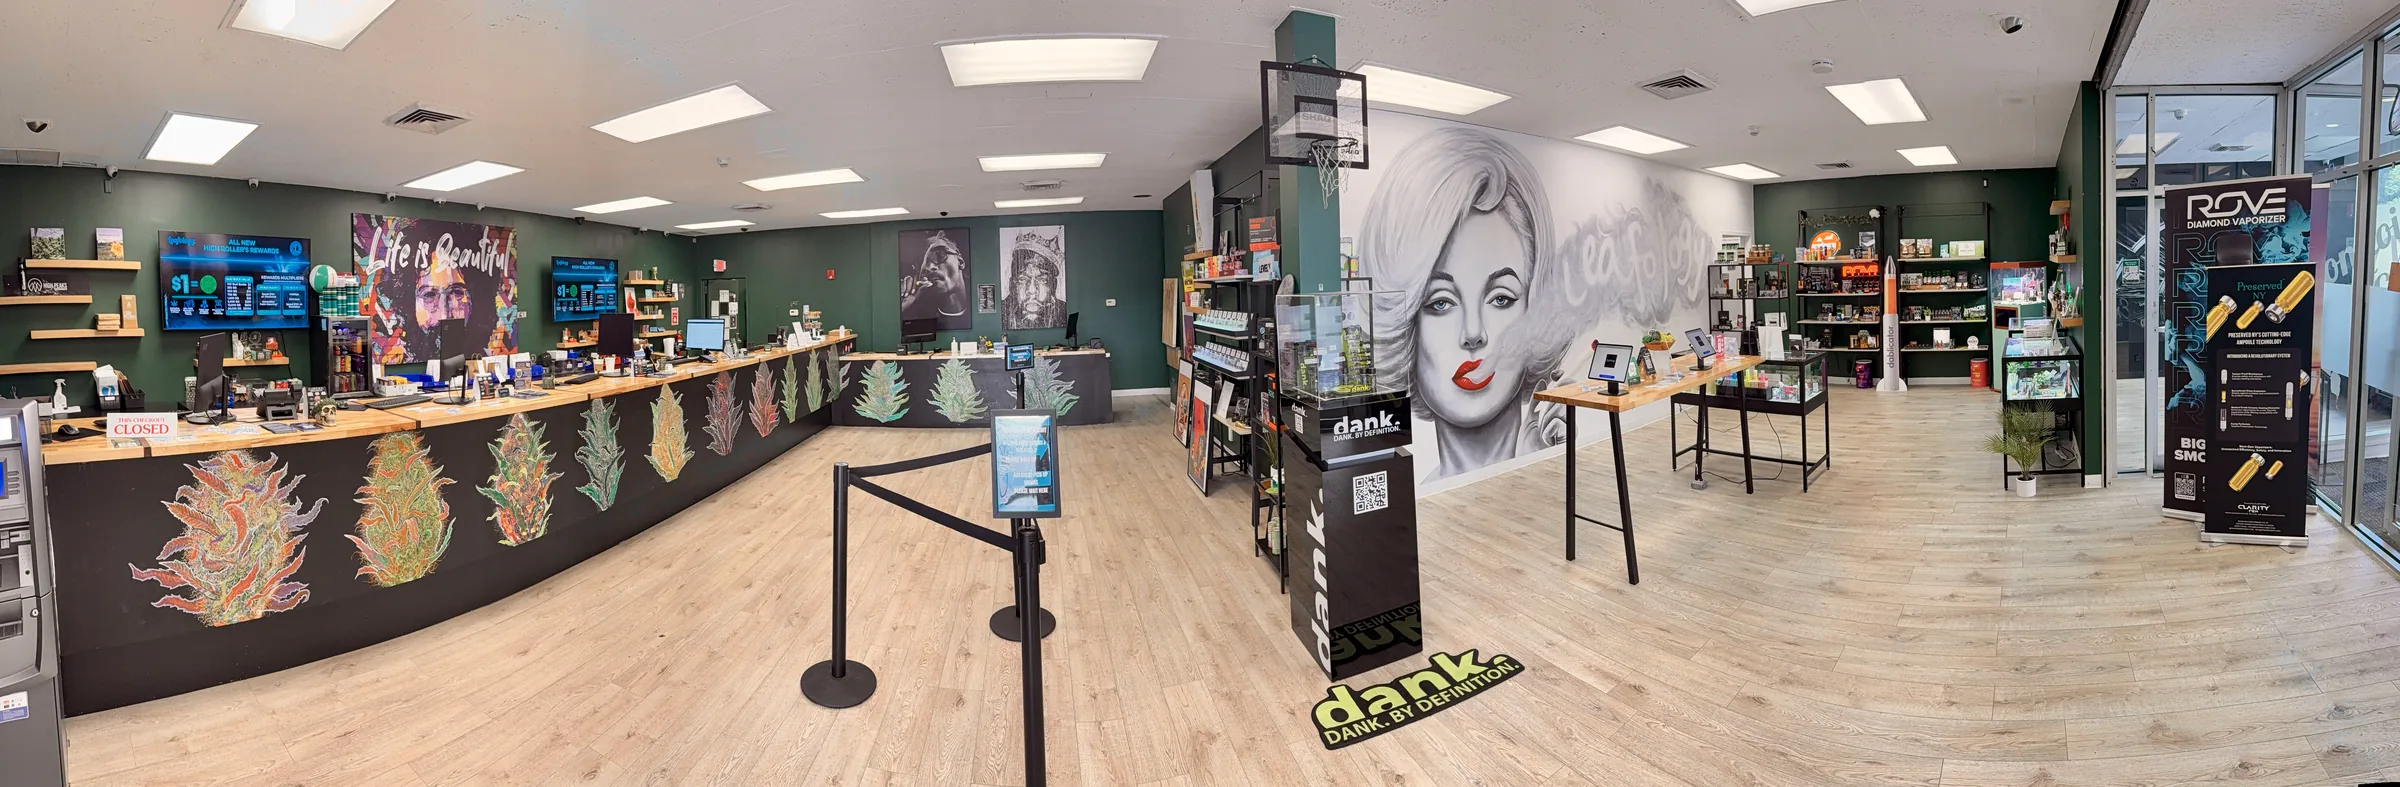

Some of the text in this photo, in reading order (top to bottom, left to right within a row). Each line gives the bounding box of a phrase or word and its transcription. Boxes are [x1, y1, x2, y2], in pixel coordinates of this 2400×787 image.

[2187, 188, 2286, 219] ROVE
[2187, 215, 2286, 229] DIAMOND VAPORIZER
[366, 226, 513, 277] Life is Beautiful
[2237, 280, 2283, 291] Preserved
[2252, 292, 2266, 300] NY
[1887, 326, 1895, 369] dablicator
[1291, 403, 1308, 417] dank.
[114, 424, 169, 435] CLOSED
[1334, 410, 1400, 435] dank.
[1333, 426, 1401, 442] DANK. BY DEFINITION.
[2181, 437, 2206, 450] BIG
[1306, 488, 1331, 673] dank.
[1315, 650, 1508, 729] dank.
[1323, 661, 1520, 745] DANK. BY DEFINITION.
